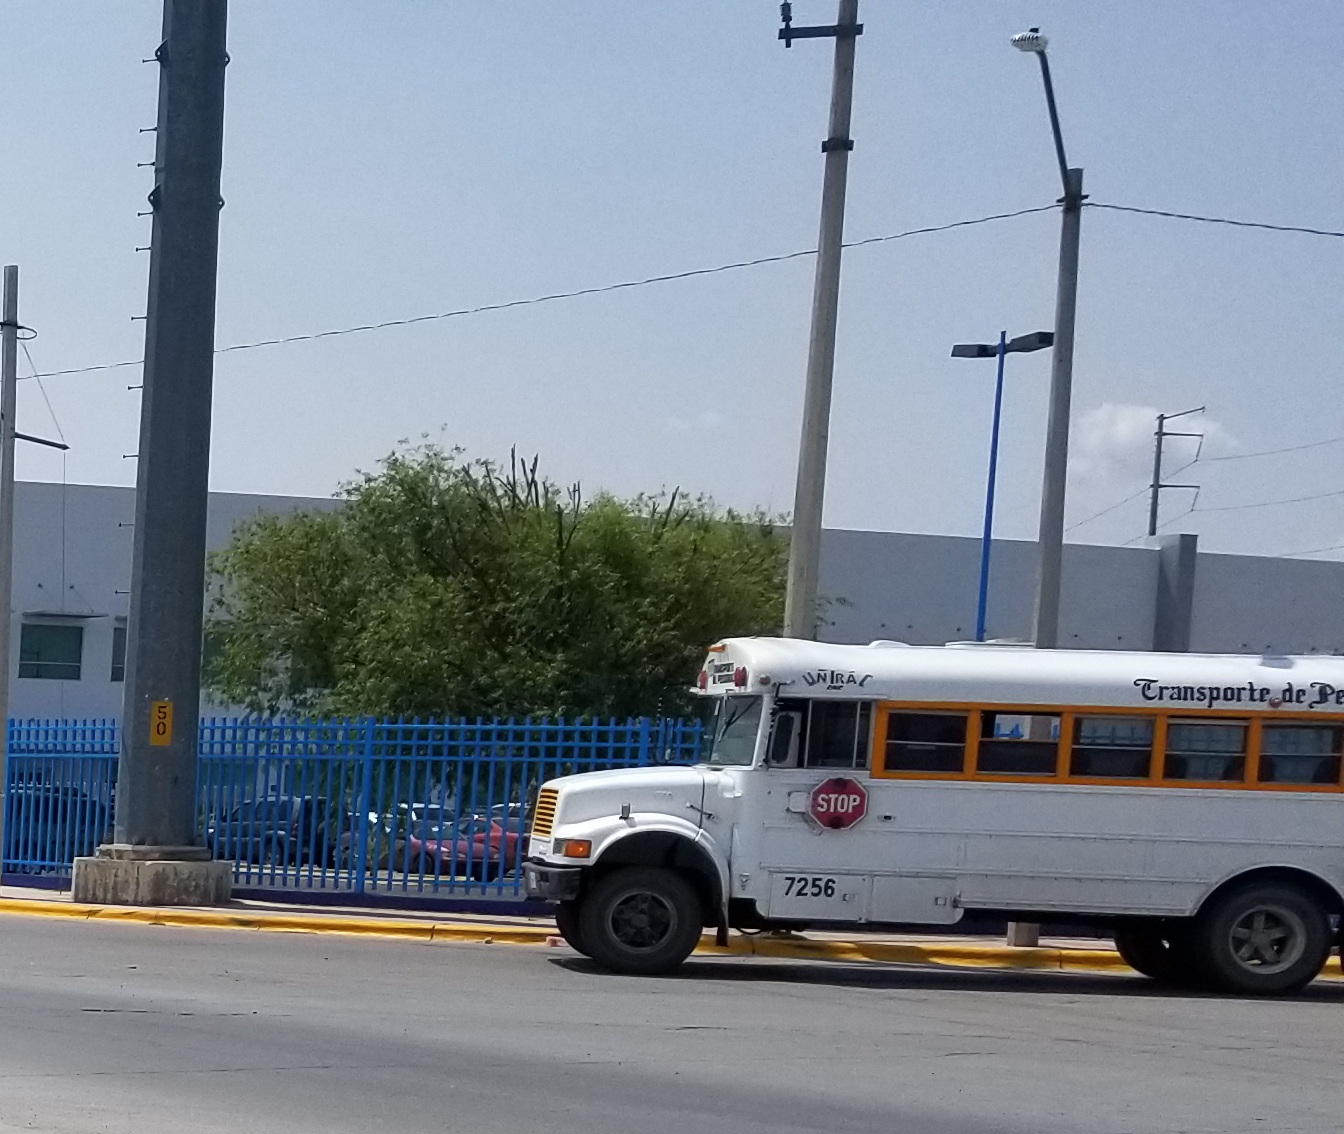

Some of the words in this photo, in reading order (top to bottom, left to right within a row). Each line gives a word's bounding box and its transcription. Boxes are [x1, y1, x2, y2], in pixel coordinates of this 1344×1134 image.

[1133, 678, 1270, 709] Transporte
[1281, 682, 1307, 704] de
[817, 793, 861, 814] STOP
[784, 876, 836, 898] 7256
